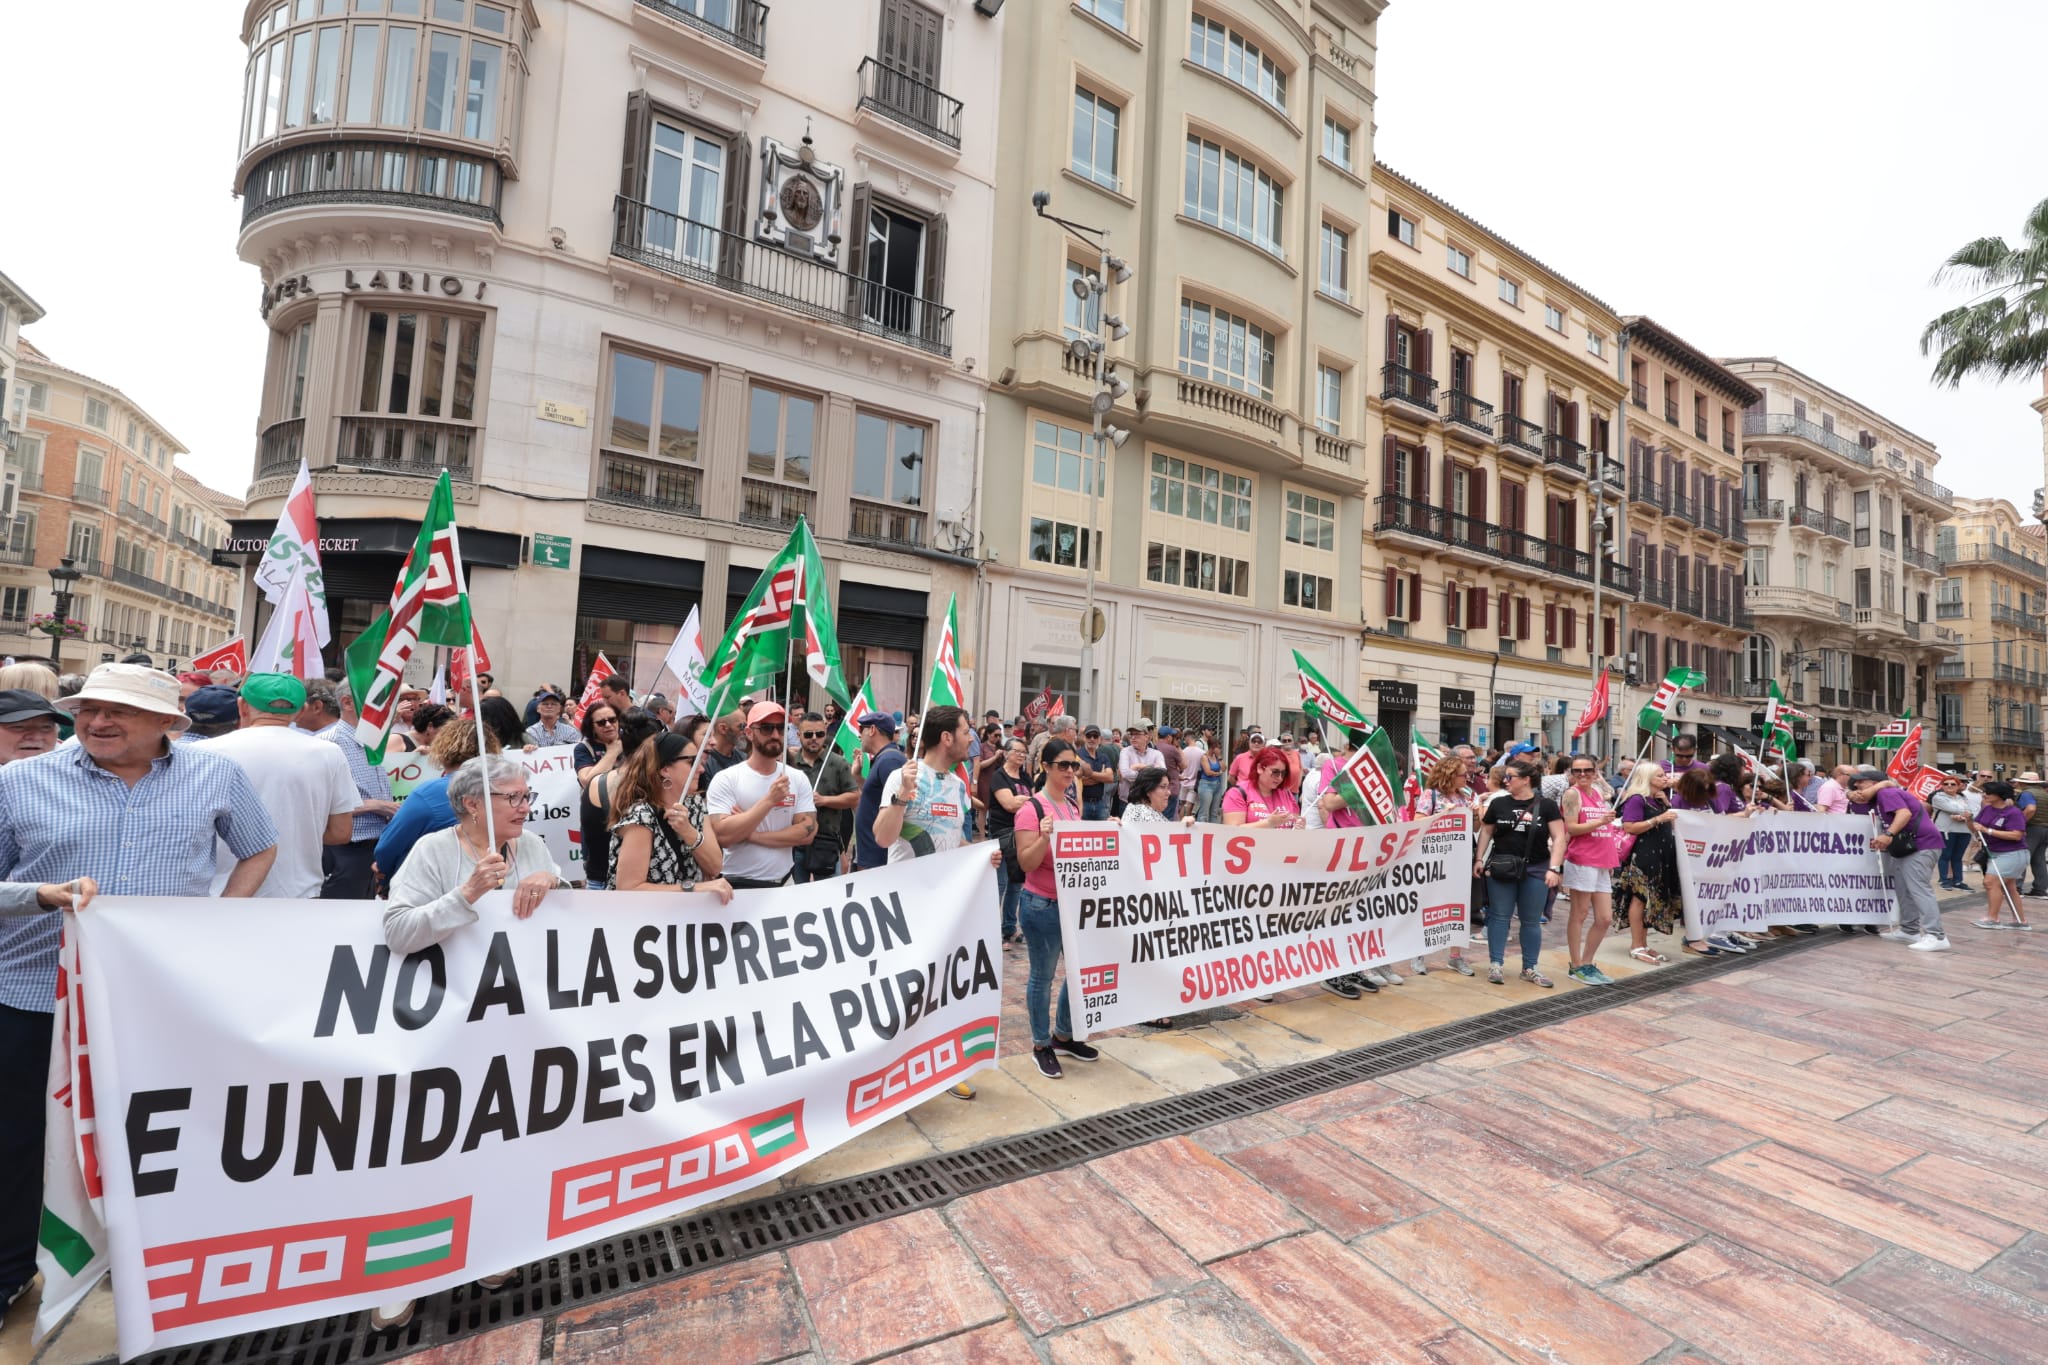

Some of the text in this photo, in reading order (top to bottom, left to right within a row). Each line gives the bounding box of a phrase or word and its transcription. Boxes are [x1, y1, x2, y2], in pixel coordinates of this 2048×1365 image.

[345, 269, 487, 300] LARIOS
[224, 538, 359, 551] VICTOR ECRET
[1171, 681, 1223, 697] HOFF
[1060, 837, 1104, 852] CCOO
[1140, 833, 1256, 881] PTIS
[1326, 828, 1421, 872] ILSE
[1421, 832, 1466, 845] enseñanza
[1775, 831, 1791, 854] EN
[1056, 858, 1120, 873] enseñanza
[1079, 860, 1447, 930] PERSONAL TÉCNICO INTEGRACIÓN SOCIAL
[1827, 897, 1853, 913] CADA
[1131, 891, 1419, 963] INTÉRPRETES LENGUA DE SIGNOS
[313, 883, 913, 1037] NO A LA SUPRESIÓN
[1180, 927, 1387, 1004] SUBROGACIÓN ¡YA!
[220, 1033, 656, 1183] UNIDADES
[669, 1015, 745, 1103] EN
[752, 1000, 831, 1077] LA
[829, 939, 1000, 1053] PÚBLICA
[853, 1039, 957, 1113] CCOO
[562, 1133, 750, 1221] CCOO
[145, 1235, 347, 1315] COO
